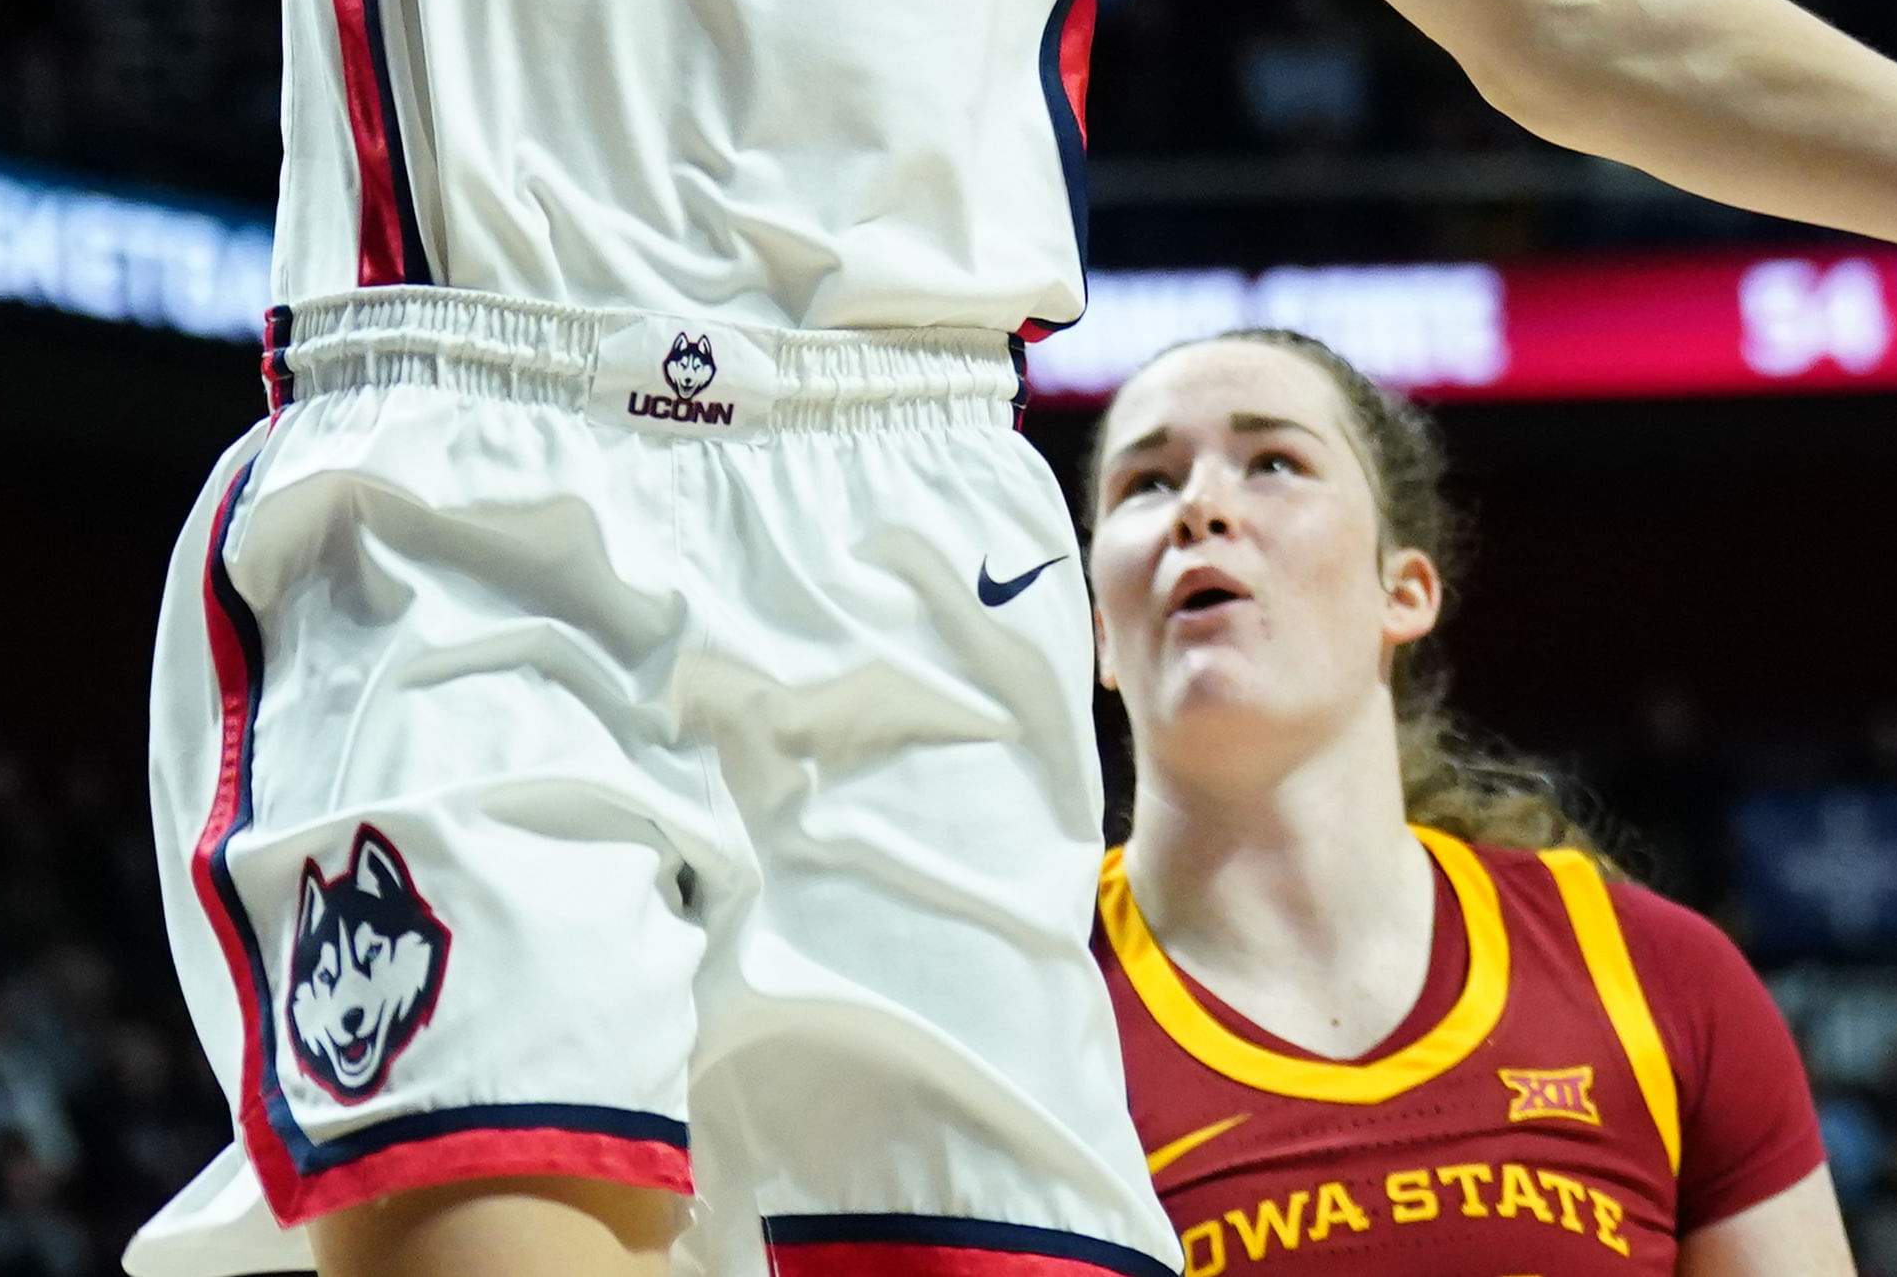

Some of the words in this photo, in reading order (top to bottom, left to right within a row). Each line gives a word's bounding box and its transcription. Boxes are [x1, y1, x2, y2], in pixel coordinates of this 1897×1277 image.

[1737, 256, 1893, 378] 54
[627, 390, 734, 426] UCONN
[1384, 1163, 1631, 1258] STATE
